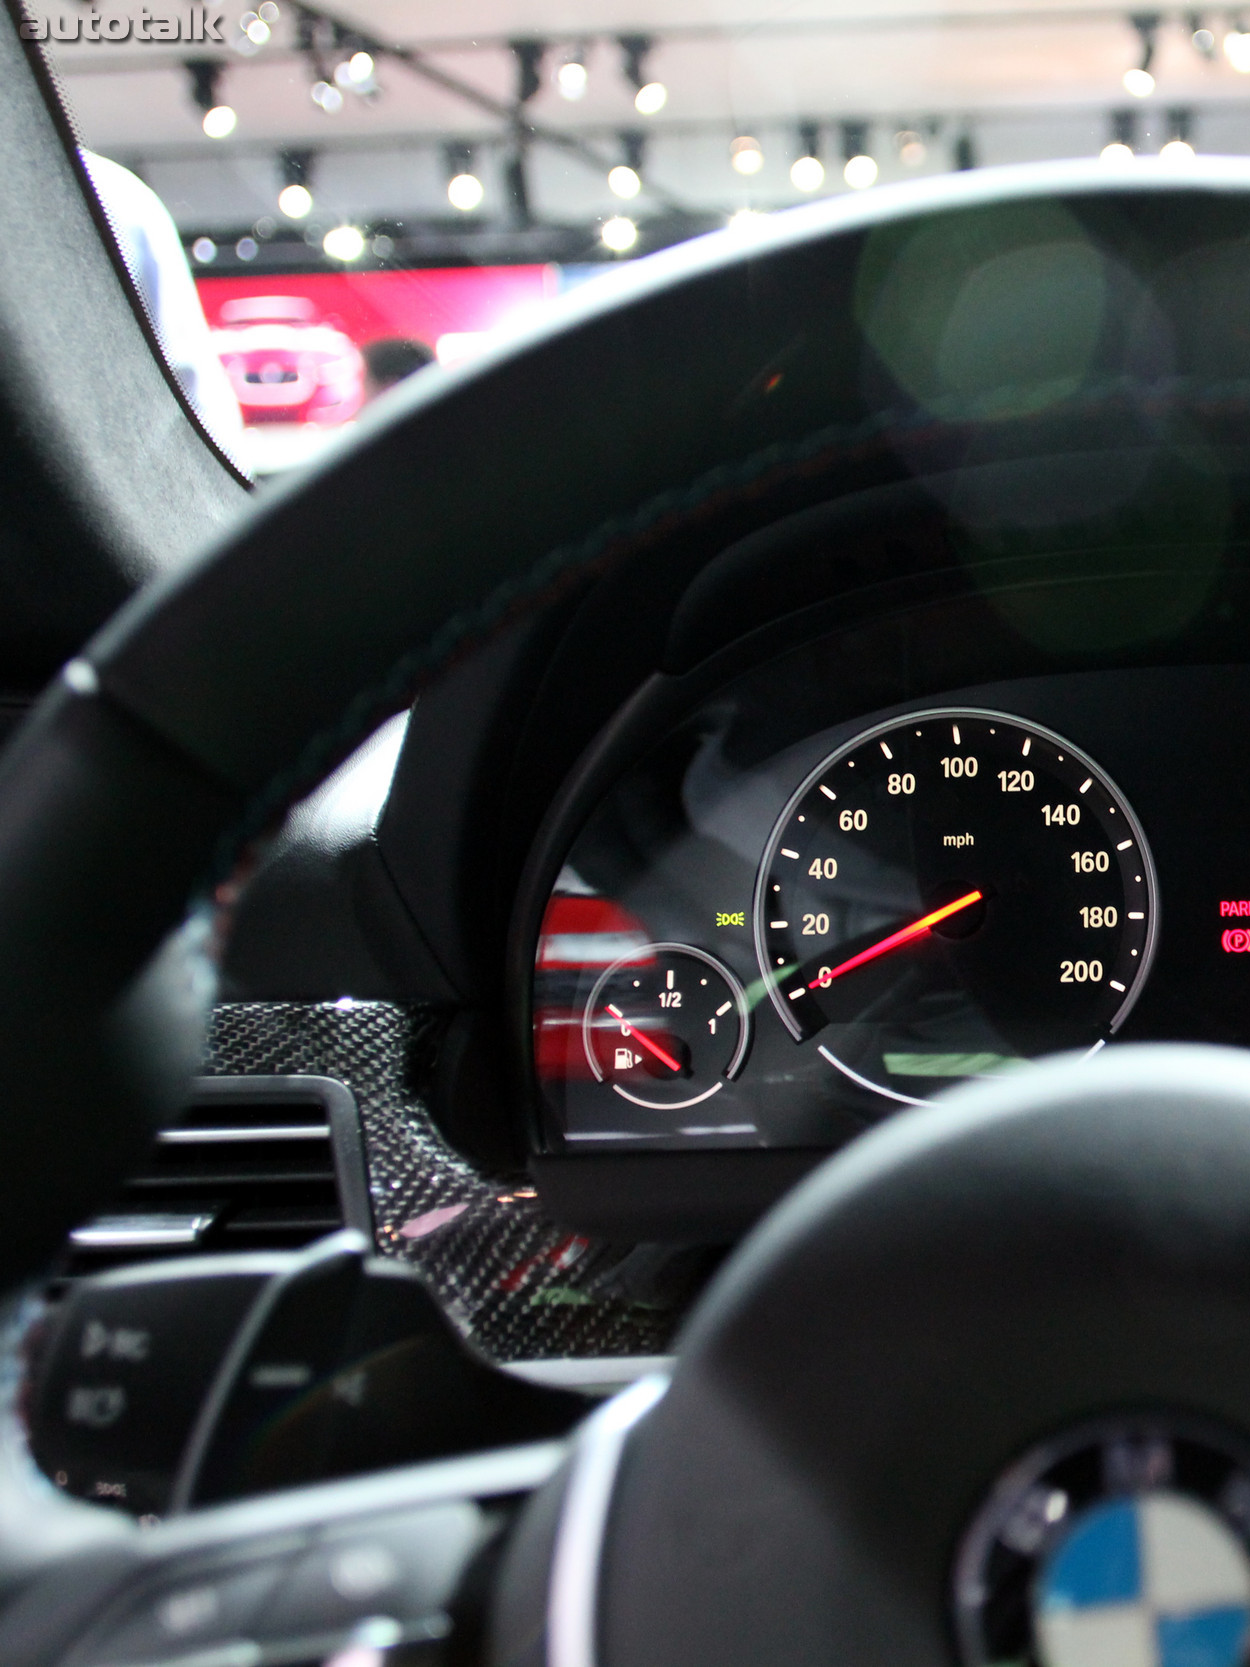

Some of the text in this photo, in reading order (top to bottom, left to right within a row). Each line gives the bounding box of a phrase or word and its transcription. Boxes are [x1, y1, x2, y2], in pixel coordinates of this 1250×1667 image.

[940, 756, 978, 778] 100
[887, 773, 916, 795] 80
[997, 770, 1035, 792] 120
[839, 809, 868, 832] 60
[1041, 804, 1081, 826] 140
[943, 832, 974, 849] mph
[808, 857, 838, 880] 40
[1070, 850, 1110, 873] 160
[801, 912, 830, 936] 20
[1079, 906, 1118, 929] 180
[818, 966, 832, 989] 0
[1060, 960, 1103, 983] 200
[658, 991, 682, 1008] 1/2
[708, 1017, 716, 1035] 1
